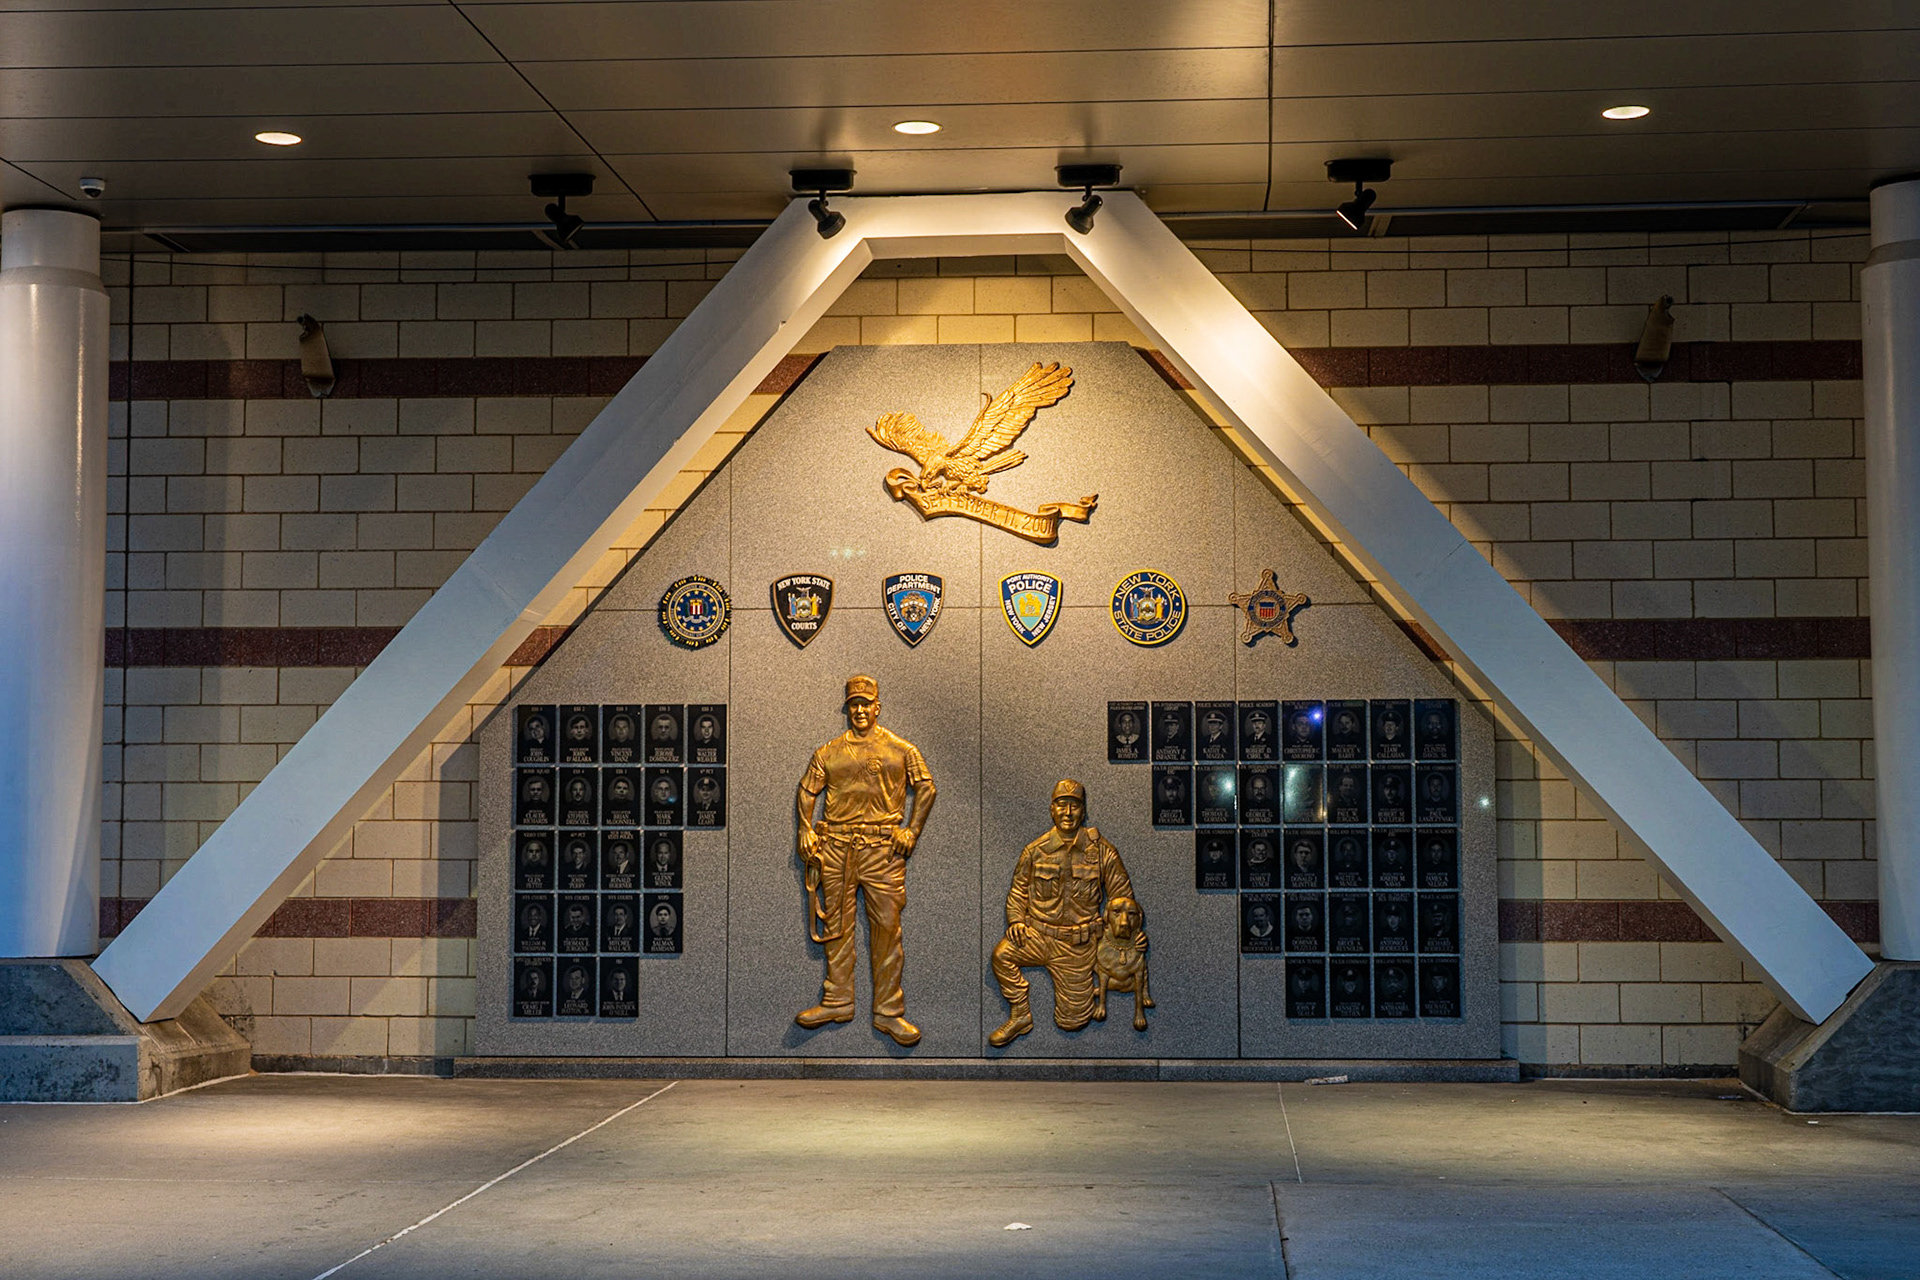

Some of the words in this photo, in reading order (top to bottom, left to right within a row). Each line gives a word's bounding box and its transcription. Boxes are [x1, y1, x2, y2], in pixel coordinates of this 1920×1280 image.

[1022, 515, 1054, 534] 2001
[778, 579, 791, 590] NEW
[812, 577, 830, 590] STATE
[887, 582, 940, 595] DEPARTMENT
[1006, 575, 1022, 584] PORT
[1022, 574, 1053, 583] AUTHORITY
[1008, 580, 1052, 593] POLICE
[1116, 574, 1141, 599] NEW
[1148, 573, 1179, 600] YORK
[791, 622, 817, 630] COURTS
[888, 603, 899, 620] CITY
[897, 621, 907, 631] OF
[919, 618, 932, 634] NEW
[930, 598, 940, 616] YORK
[1005, 600, 1014, 616] NEW
[1011, 616, 1026, 634] YORK
[1031, 622, 1045, 637] NEW
[1044, 595, 1056, 623] JERSEY
[1114, 610, 1143, 640] STATE
[1146, 610, 1181, 640] POLICE
